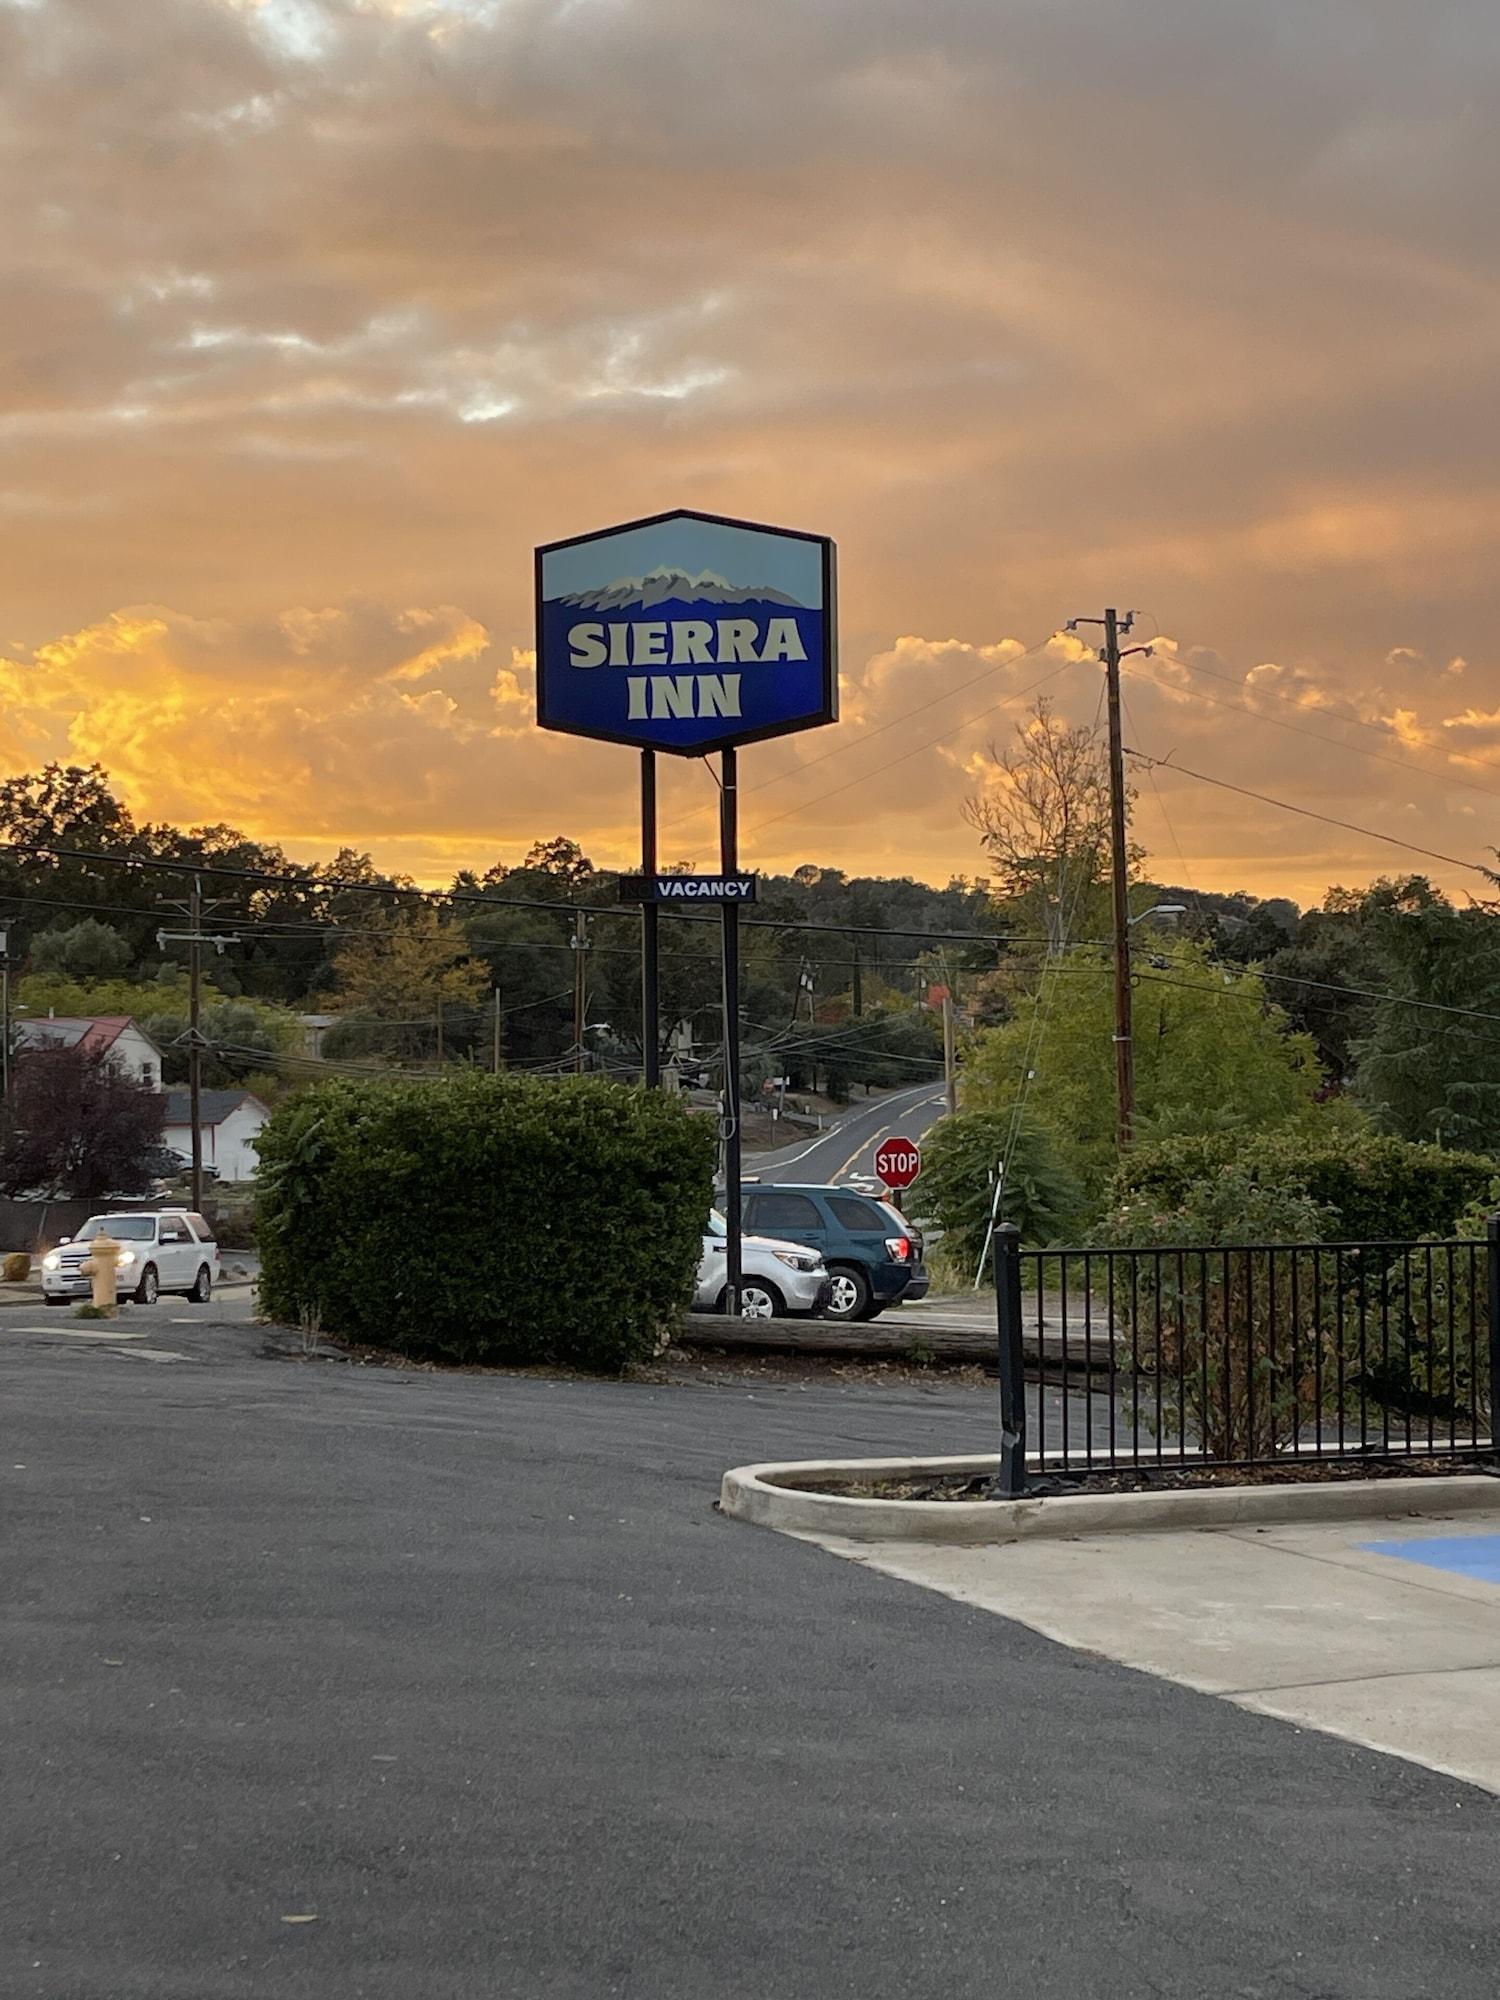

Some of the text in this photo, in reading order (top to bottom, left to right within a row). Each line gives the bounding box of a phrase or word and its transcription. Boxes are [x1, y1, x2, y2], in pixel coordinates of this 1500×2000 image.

[567, 618, 808, 668] SIERRA
[627, 673, 742, 720] INN
[658, 881, 751, 897] VACANCY
[878, 1153, 918, 1174] STOP
